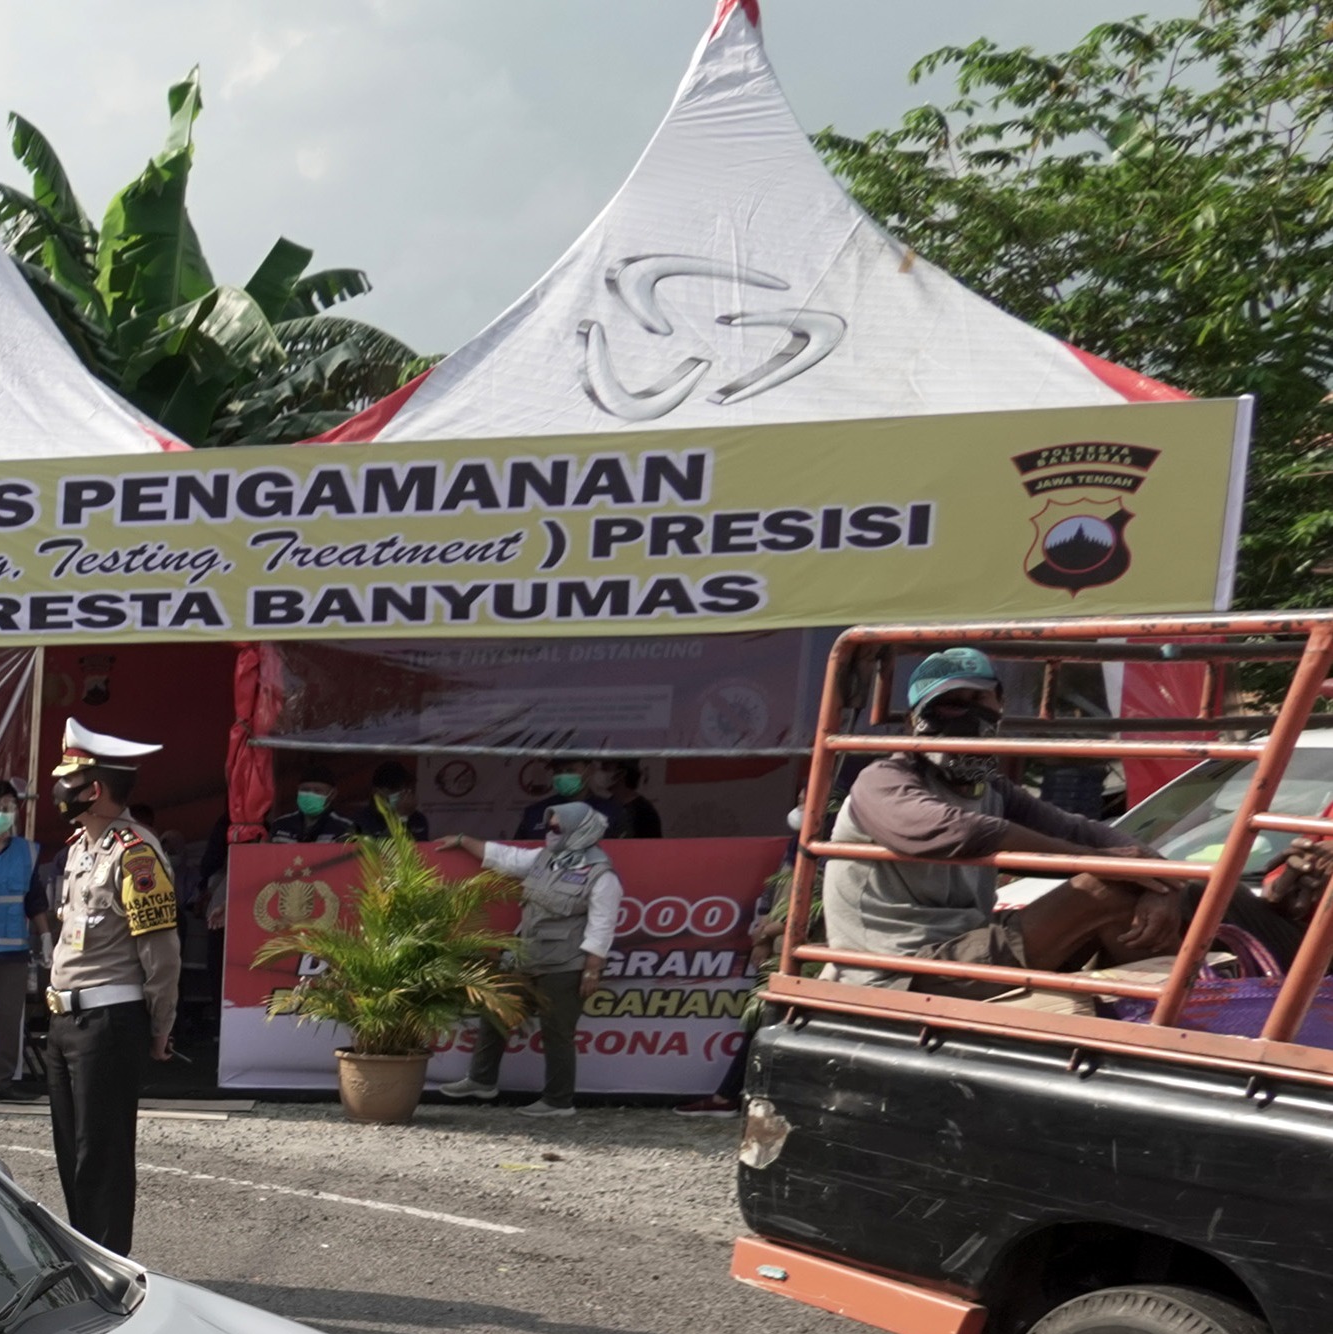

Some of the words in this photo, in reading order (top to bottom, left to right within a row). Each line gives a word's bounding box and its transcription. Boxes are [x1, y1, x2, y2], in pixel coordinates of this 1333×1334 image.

[1036, 453, 1133, 468] BANYUMAS
[1041, 445, 1131, 458] POLRESTA
[62, 453, 707, 525] PENGAMANAN
[1034, 476, 1074, 490] JAWA
[1077, 474, 1134, 487] TENGAH
[38, 537, 233, 584] Testing,
[250, 530, 525, 572] Treatment
[591, 503, 932, 559] PRESISI
[252, 575, 761, 627] BANYUMAS
[568, 642, 704, 663] DISTANCING
